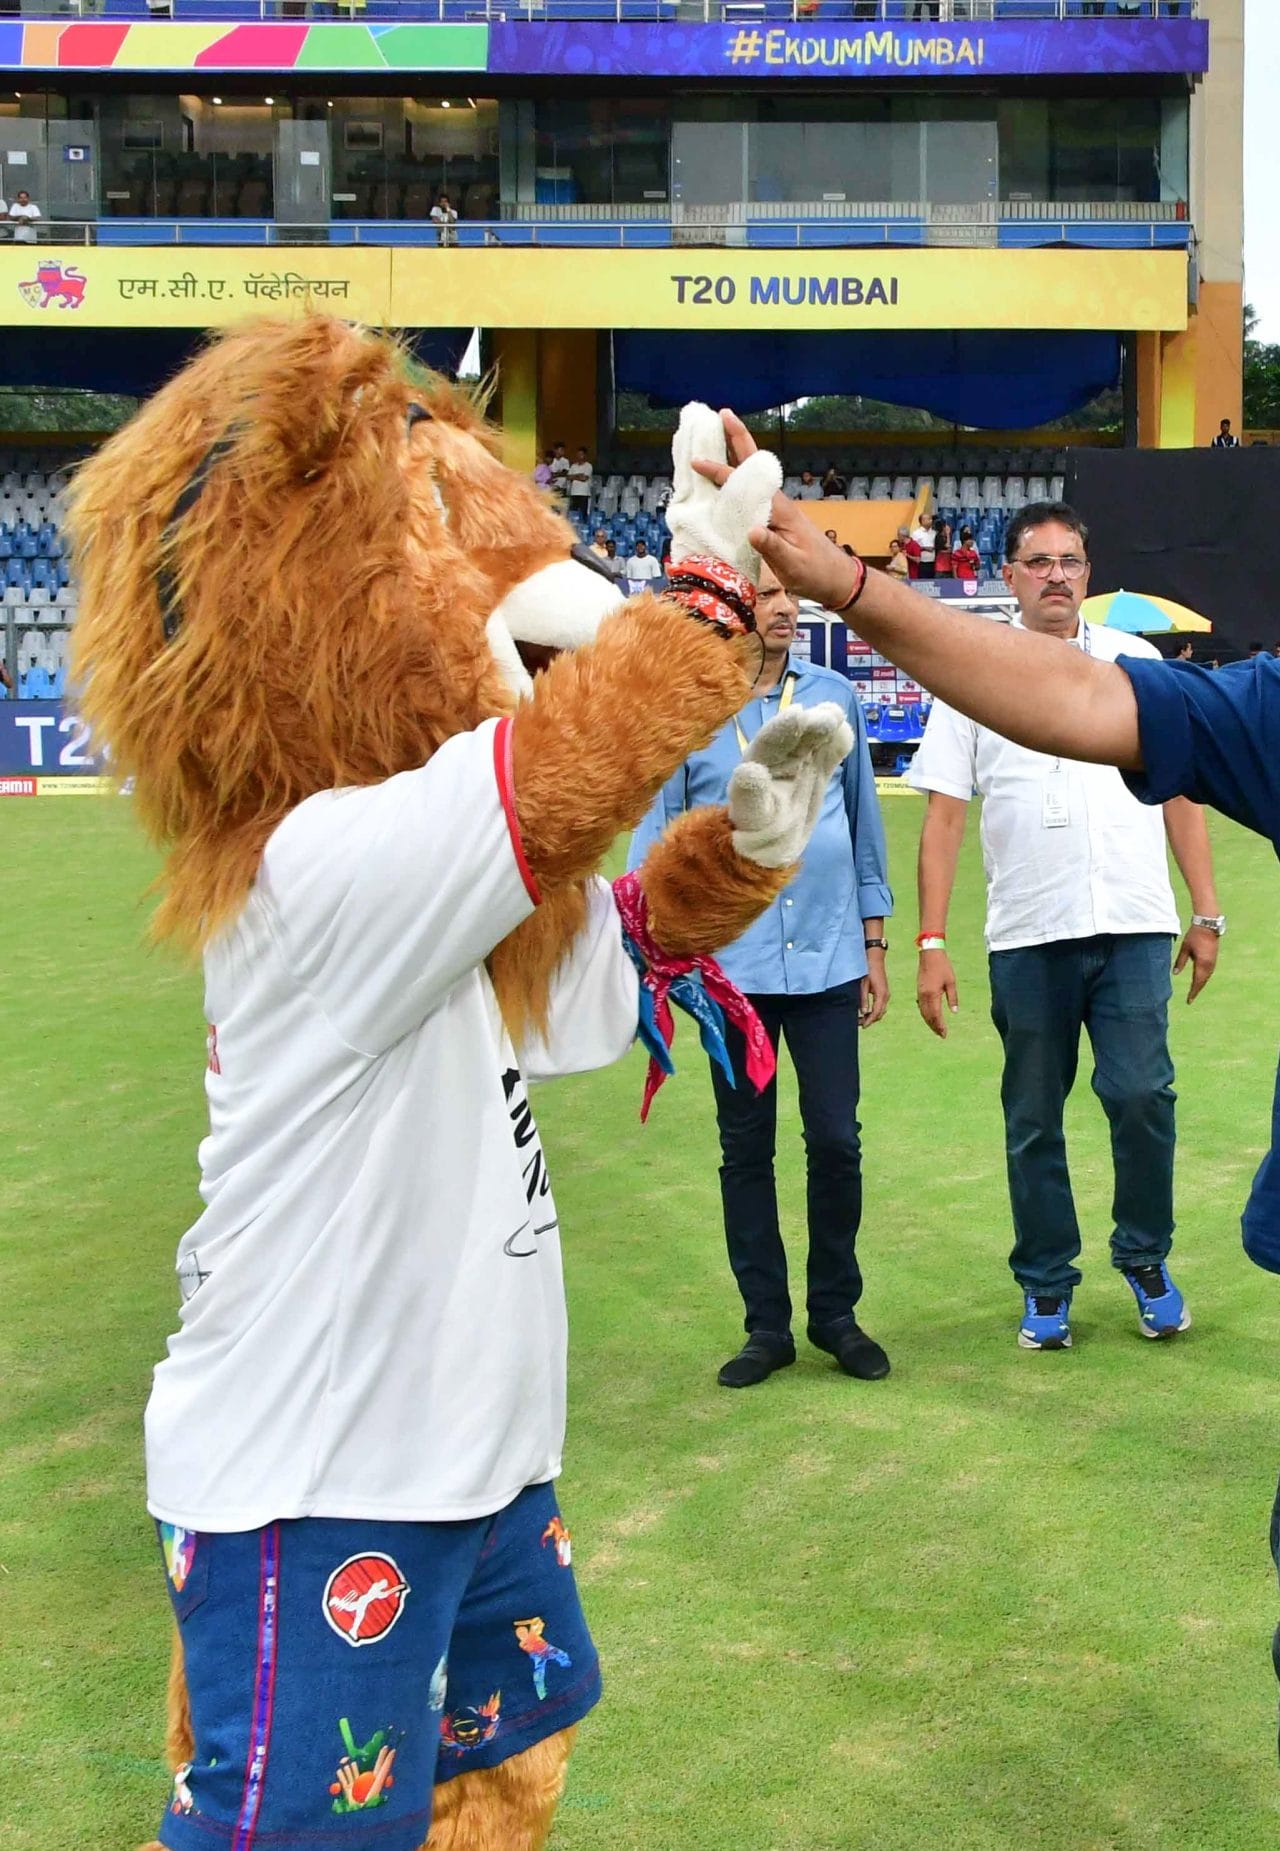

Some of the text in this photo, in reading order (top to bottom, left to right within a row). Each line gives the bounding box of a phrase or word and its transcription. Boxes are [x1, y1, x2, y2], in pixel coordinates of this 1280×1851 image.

[118, 272, 233, 300] एम.सी.ए.
[670, 275, 898, 305] T20 MUMBAI
[14, 716, 114, 766] T2
